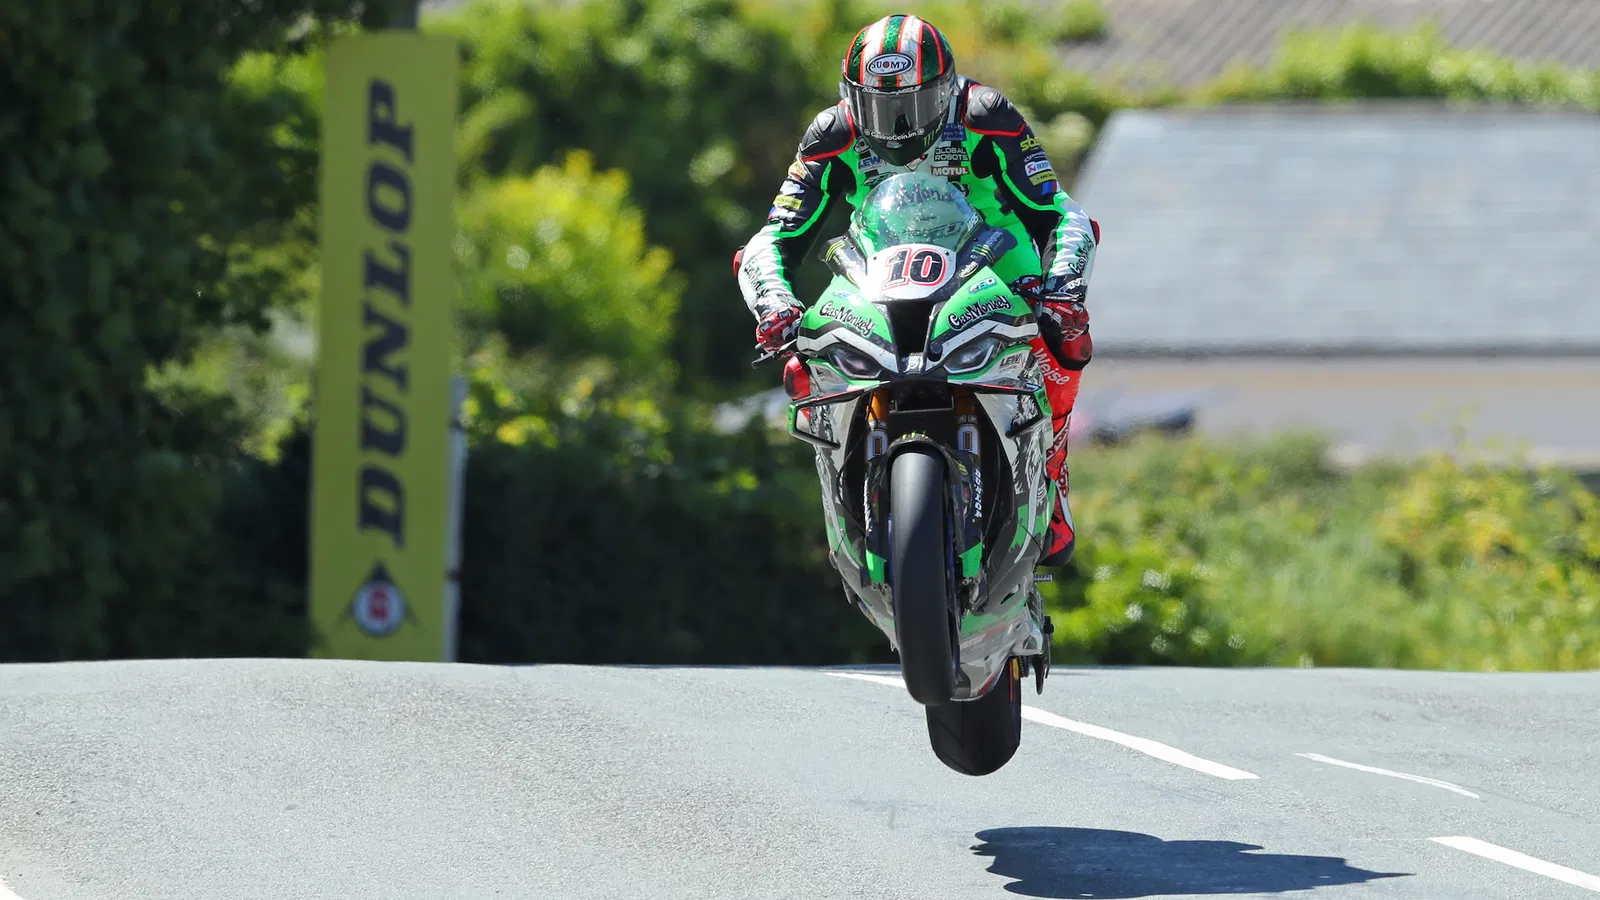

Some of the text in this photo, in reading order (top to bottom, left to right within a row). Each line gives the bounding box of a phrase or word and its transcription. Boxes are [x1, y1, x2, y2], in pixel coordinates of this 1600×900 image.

[871, 60, 908, 70] SUOMY
[935, 147, 966, 155] GLOBAL
[932, 167, 968, 176] MOTUL
[884, 248, 946, 289] 10
[357, 78, 415, 551] DUNLOP
[819, 301, 874, 336] GasMonkey
[948, 295, 1012, 330] GasMonkey
[1033, 348, 1070, 385] Weise
